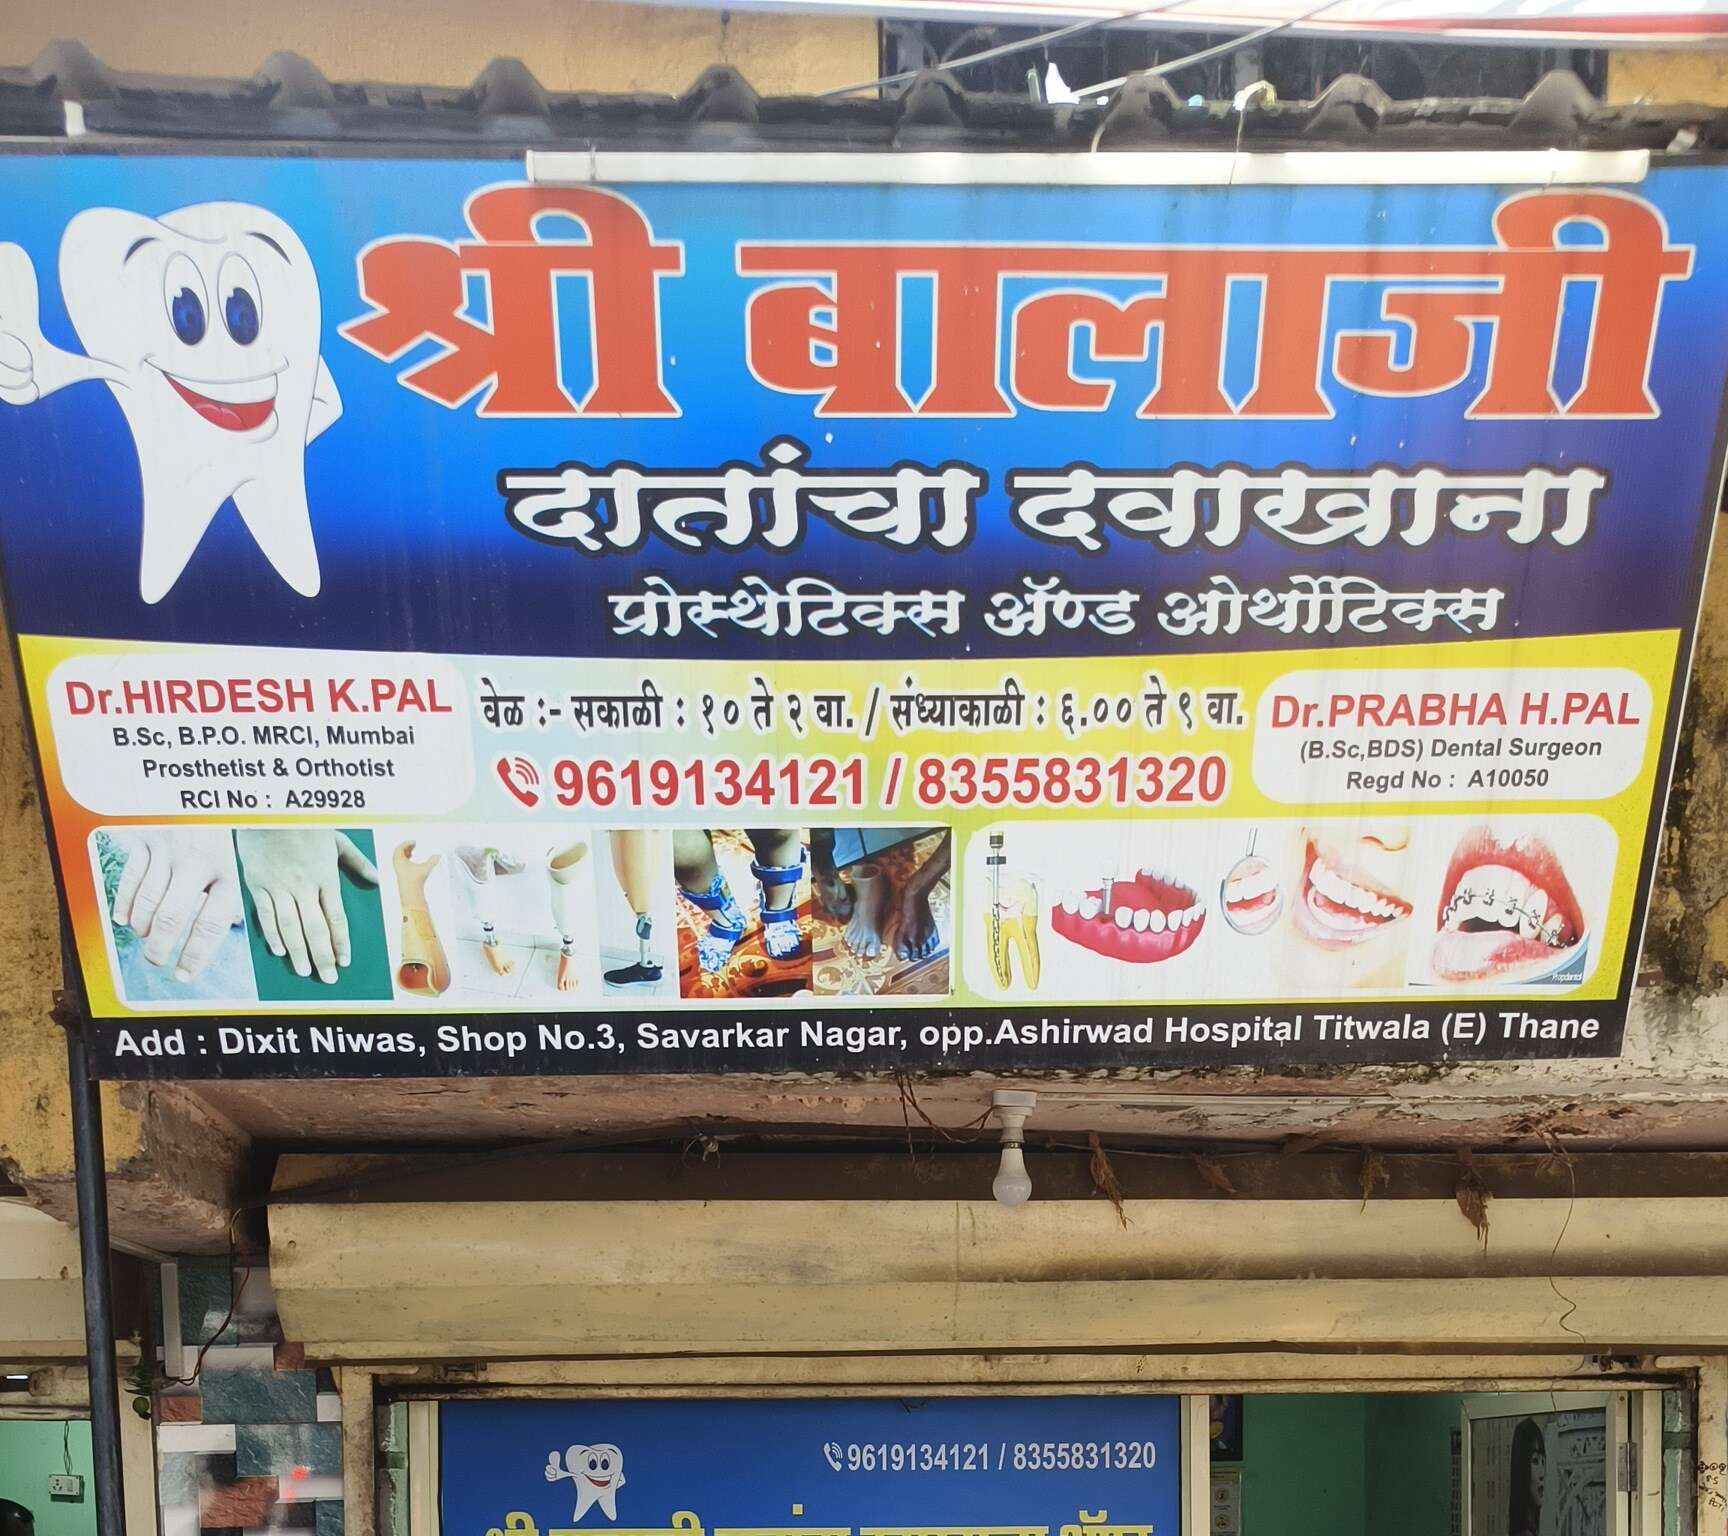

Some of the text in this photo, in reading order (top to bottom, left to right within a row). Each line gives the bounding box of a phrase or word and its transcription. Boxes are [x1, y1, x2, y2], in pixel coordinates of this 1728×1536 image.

[338, 181, 1696, 420] श्री बालाजी
[505, 443, 1606, 552] दातांचा दवाखाना
[608, 576, 966, 638] प्रोस्थेटिक्स
[66, 678, 453, 715] Dr.HIRDESH K.PAL
[480, 677, 526, 729] वेळ
[570, 678, 664, 732] सकाळी
[702, 693, 740, 735] १०
[750, 676, 774, 729] ते
[786, 693, 804, 734] २
[814, 694, 854, 729] वा.
[864, 686, 881, 737] /
[889, 675, 1026, 732] संध्याकाळी
[1144, 675, 1168, 729] ते
[1178, 691, 1194, 730] ९
[1206, 692, 1244, 726] वा.
[1271, 691, 1641, 729] Dr.PRABHA H.PAL
[112, 726, 416, 750] B.Sc, B.P.O. MRCI, Mumbai
[1300, 737, 1603, 764] (B.Sc,BDS) Dental Surgeon
[142, 757, 396, 779] Prosthetist & Orthotist
[553, 755, 1227, 806] 9619134121 / 8355831320
[1346, 771, 1404, 794] Regd
[1411, 770, 1442, 789] No
[1467, 768, 1550, 788] A10050
[180, 790, 221, 809] RCI
[227, 790, 259, 809] No
[285, 789, 367, 809] A29928
[114, 1028, 187, 1058] Add
[218, 1026, 301, 1056] Dixit
[309, 1026, 428, 1058] Niwas,
[437, 1024, 528, 1058] Shop
[538, 1023, 627, 1054] No.3,
[636, 1021, 790, 1051] Savarkar
[800, 1020, 908, 1053] Nagar,
[1164, 1014, 1302, 1048] Hospital
[1314, 1013, 1431, 1042] Titwala
[1440, 1012, 1488, 1046] (E)
[1499, 1011, 1600, 1041] Thane
[846, 1441, 1157, 1472] 9619134121 / 8355831320
